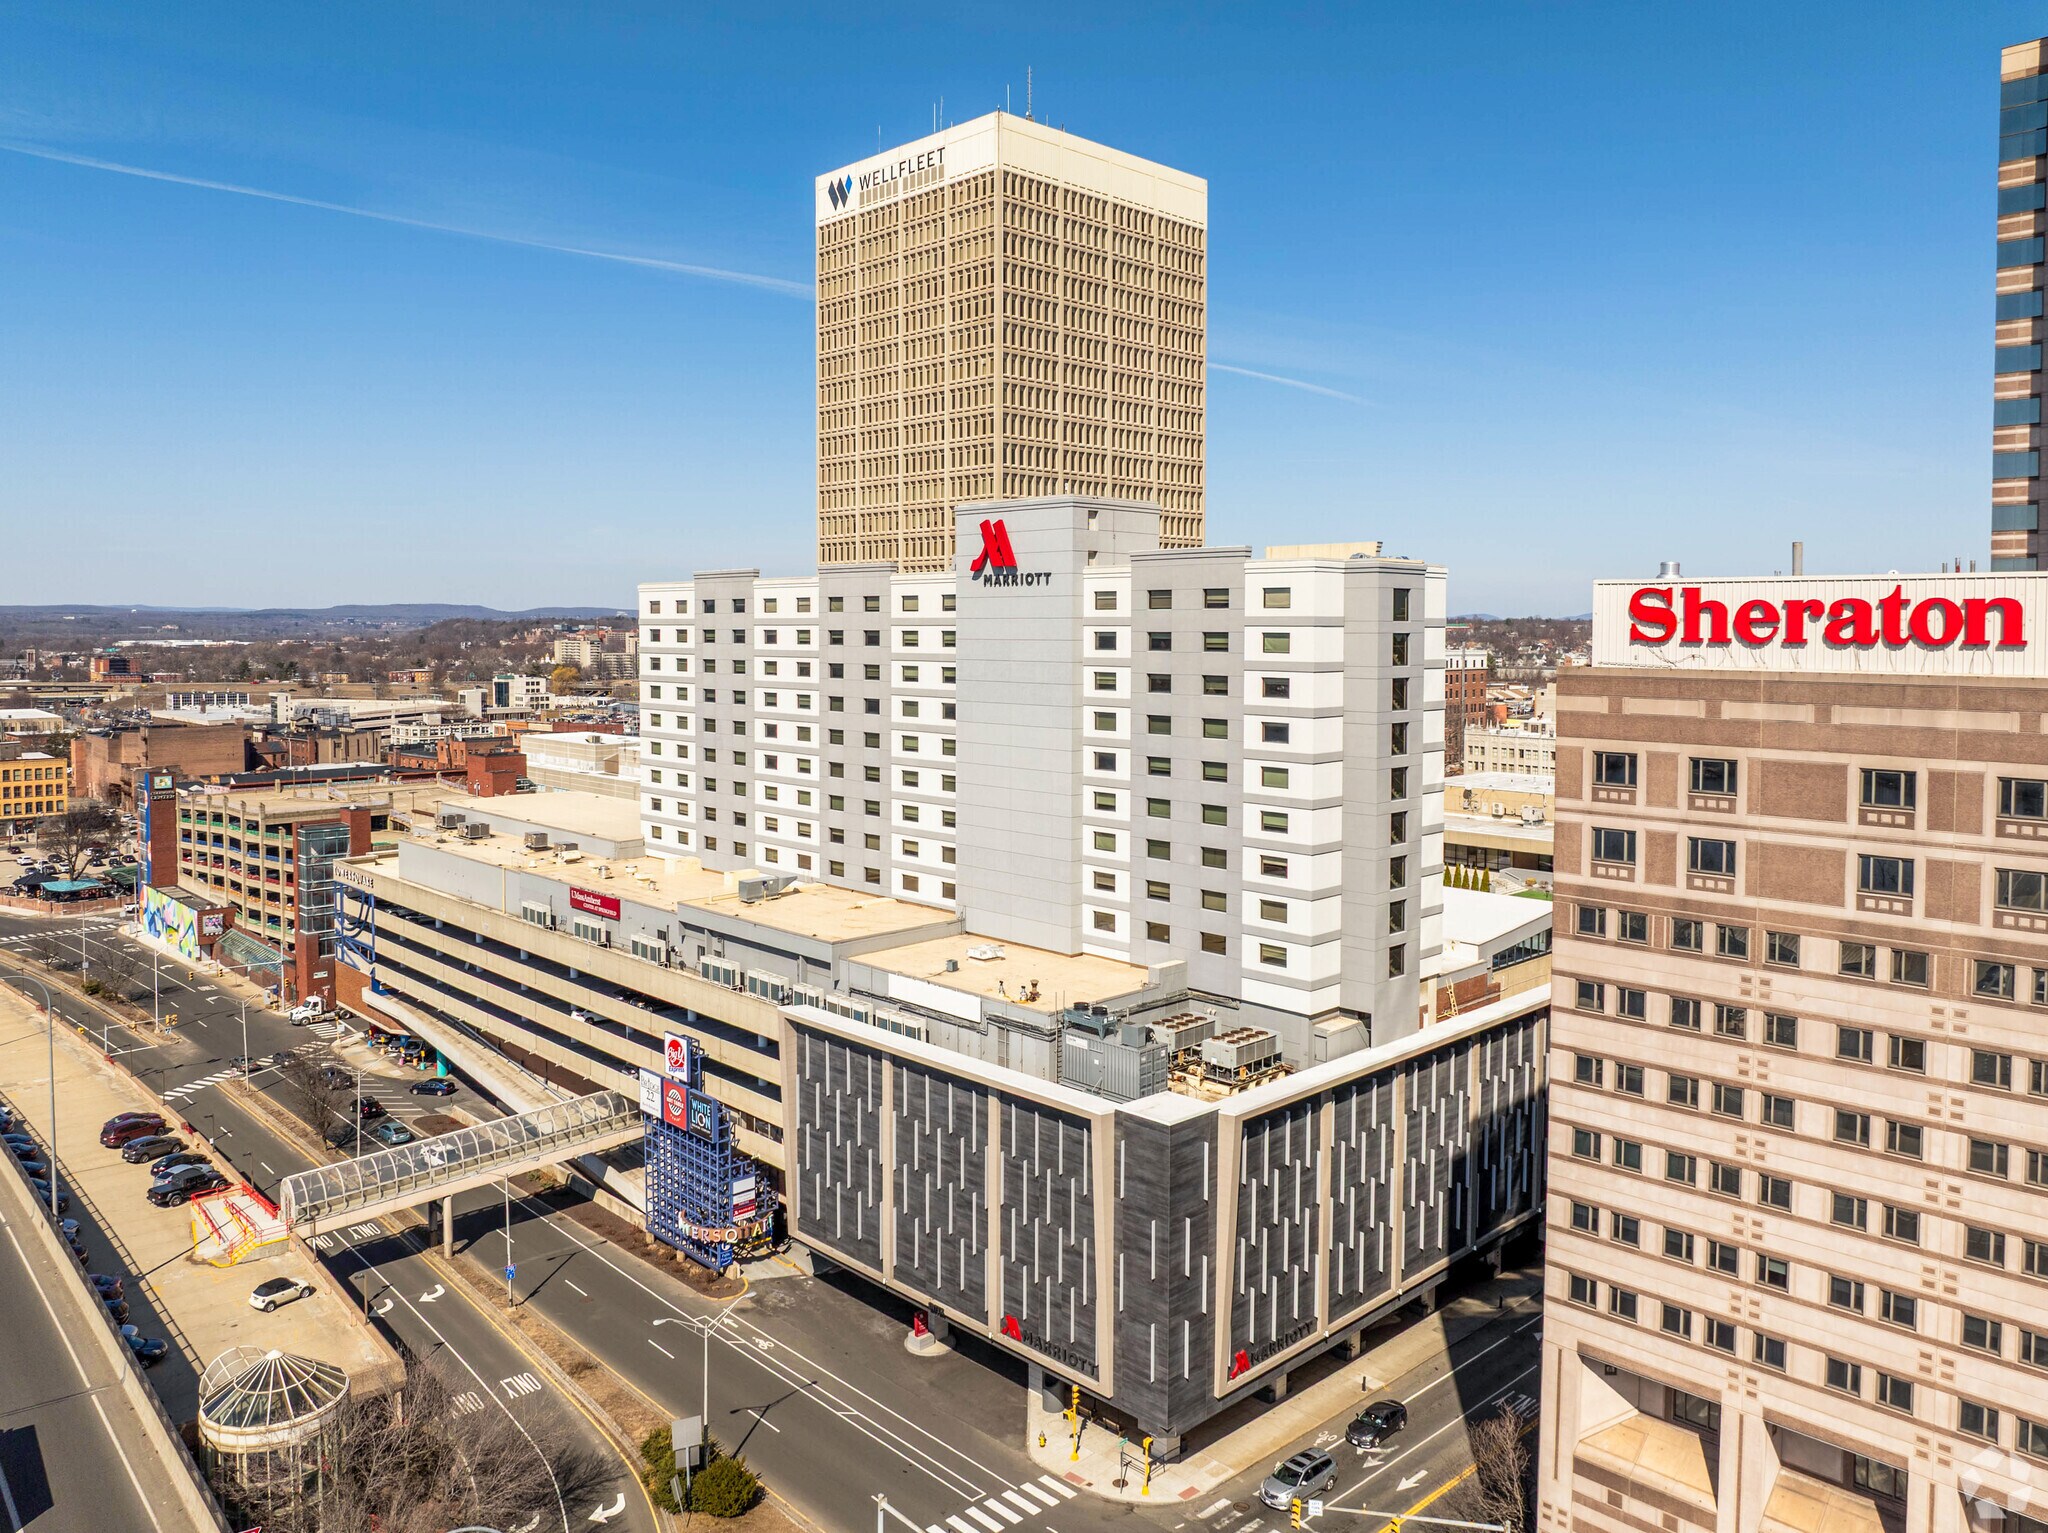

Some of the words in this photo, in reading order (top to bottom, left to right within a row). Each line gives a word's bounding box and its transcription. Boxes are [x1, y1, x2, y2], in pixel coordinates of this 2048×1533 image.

[859, 147, 945, 191] WELLFLEET
[983, 572, 1052, 587] MARRIOTT
[1628, 585, 2028, 646] Sheraton
[646, 1090, 656, 1103] 22
[691, 1098, 711, 1117] WHITE
[691, 1109, 711, 1130] LION
[347, 1222, 381, 1240] ONLY
[1023, 1330, 1098, 1376] MARRIOTT
[1250, 1319, 1313, 1366] MARRIOTT
[500, 1372, 542, 1399] ONLY
